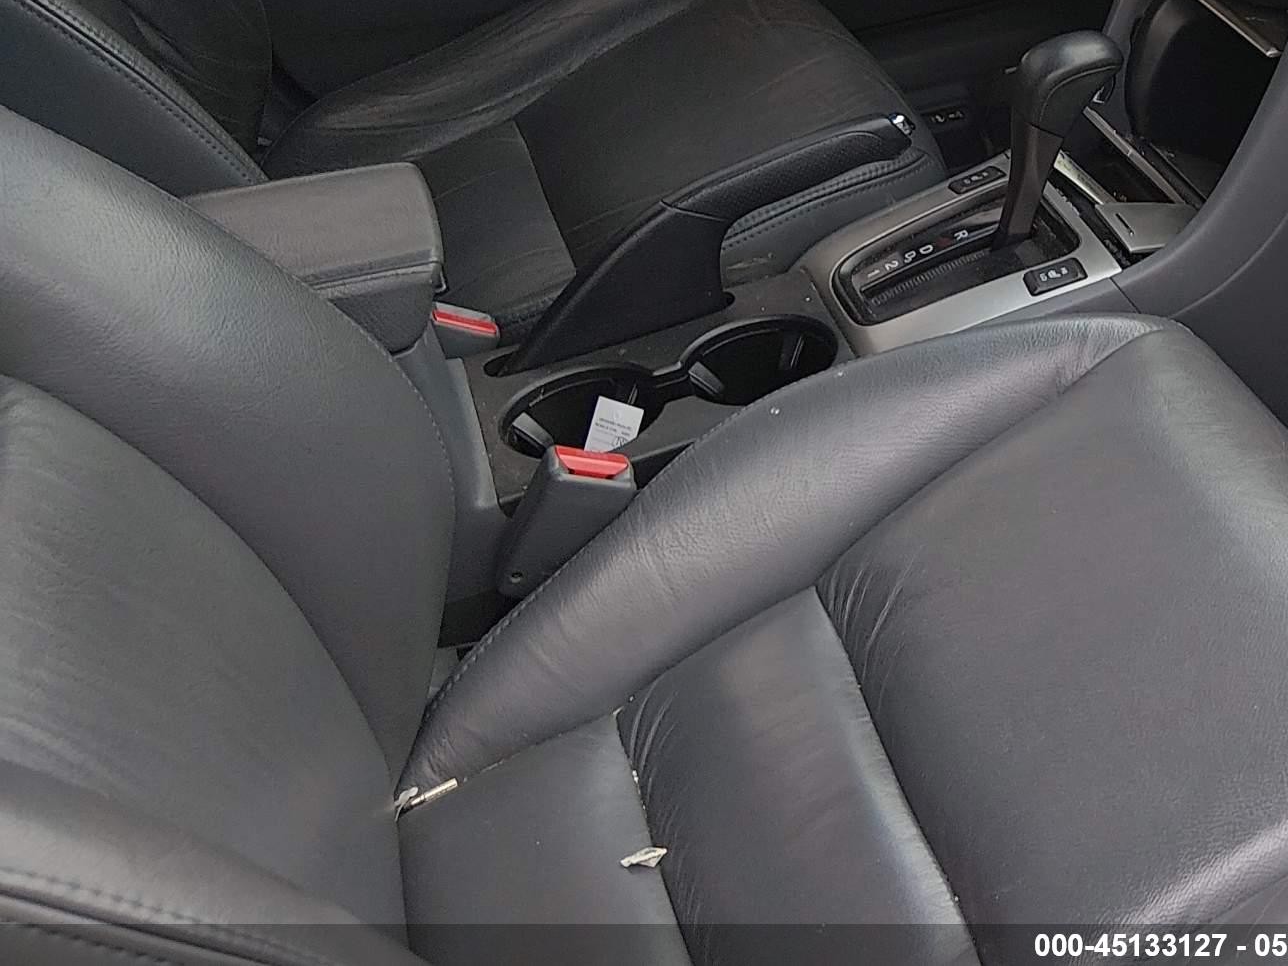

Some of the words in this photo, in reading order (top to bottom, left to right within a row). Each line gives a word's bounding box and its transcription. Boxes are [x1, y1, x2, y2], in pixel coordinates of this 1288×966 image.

[953, 229, 969, 241] R
[919, 244, 934, 255] D
[884, 260, 899, 271] 2
